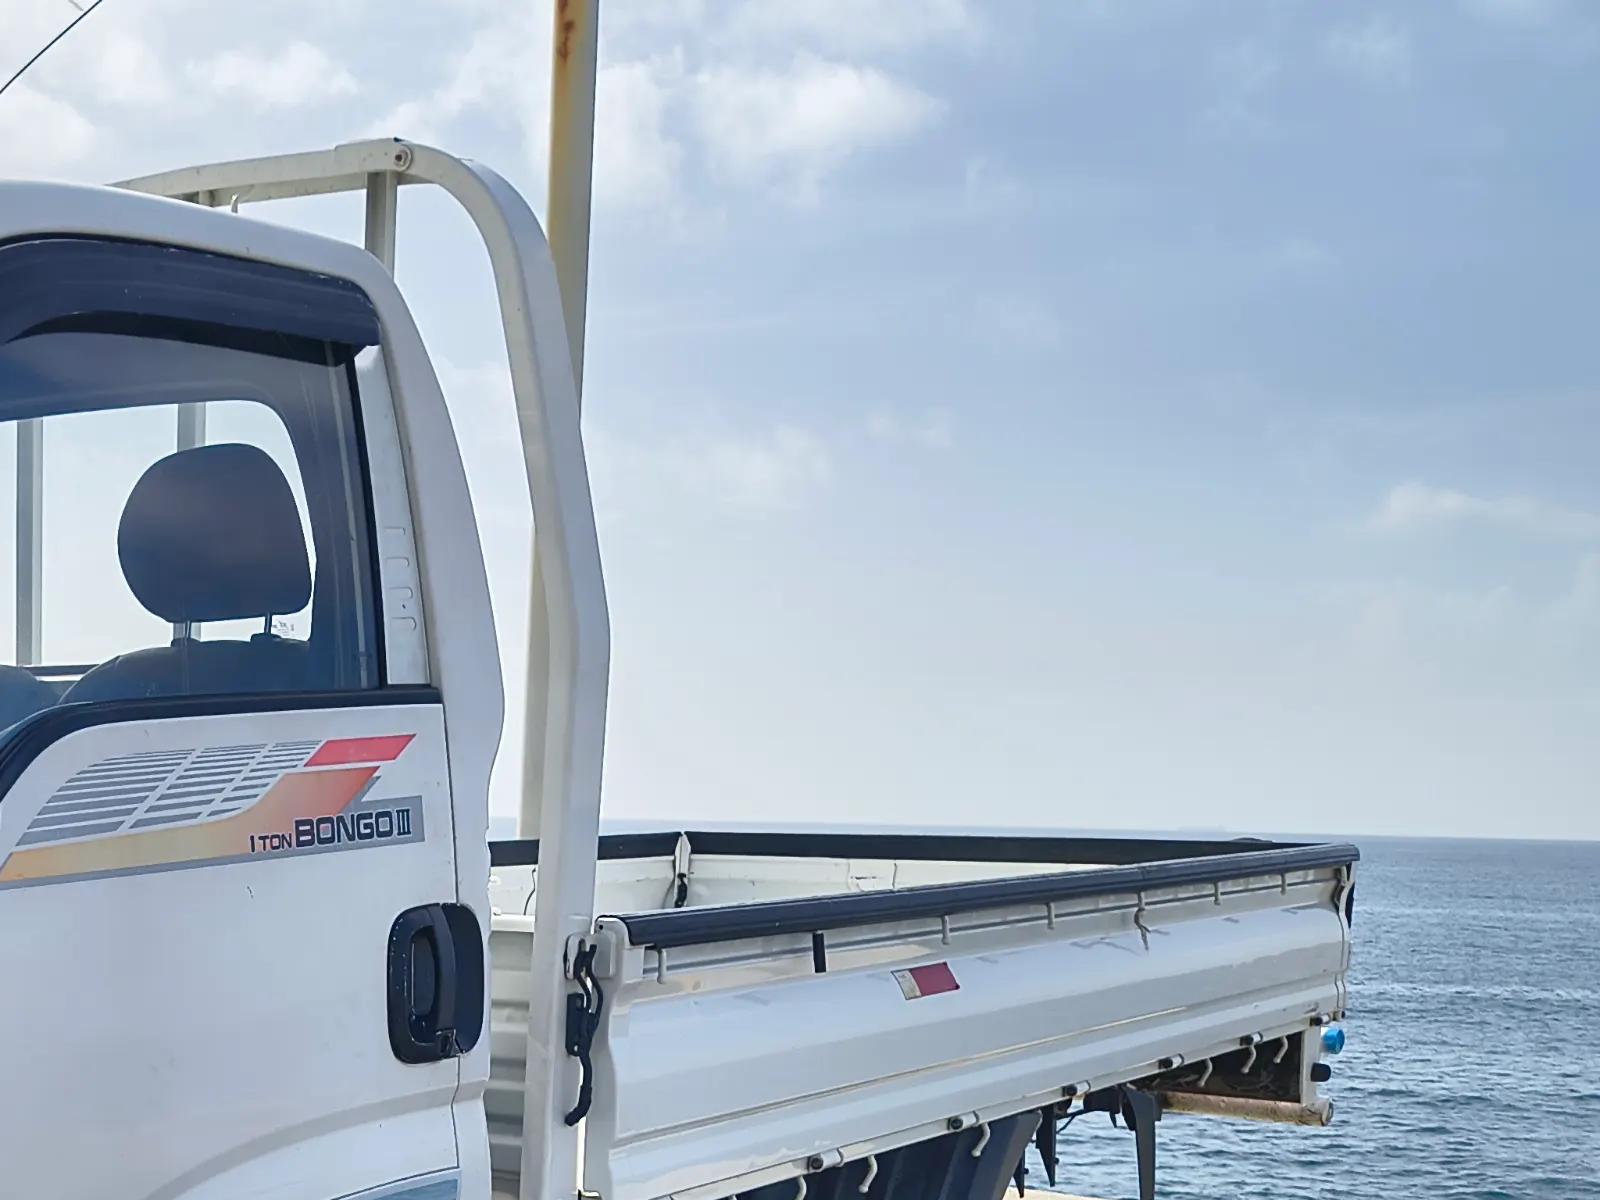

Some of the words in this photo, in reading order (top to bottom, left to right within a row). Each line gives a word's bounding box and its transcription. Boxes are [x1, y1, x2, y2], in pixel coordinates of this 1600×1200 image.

[258, 833, 292, 851] TON
[295, 811, 393, 848] BONGO
[396, 809, 411, 836] III
